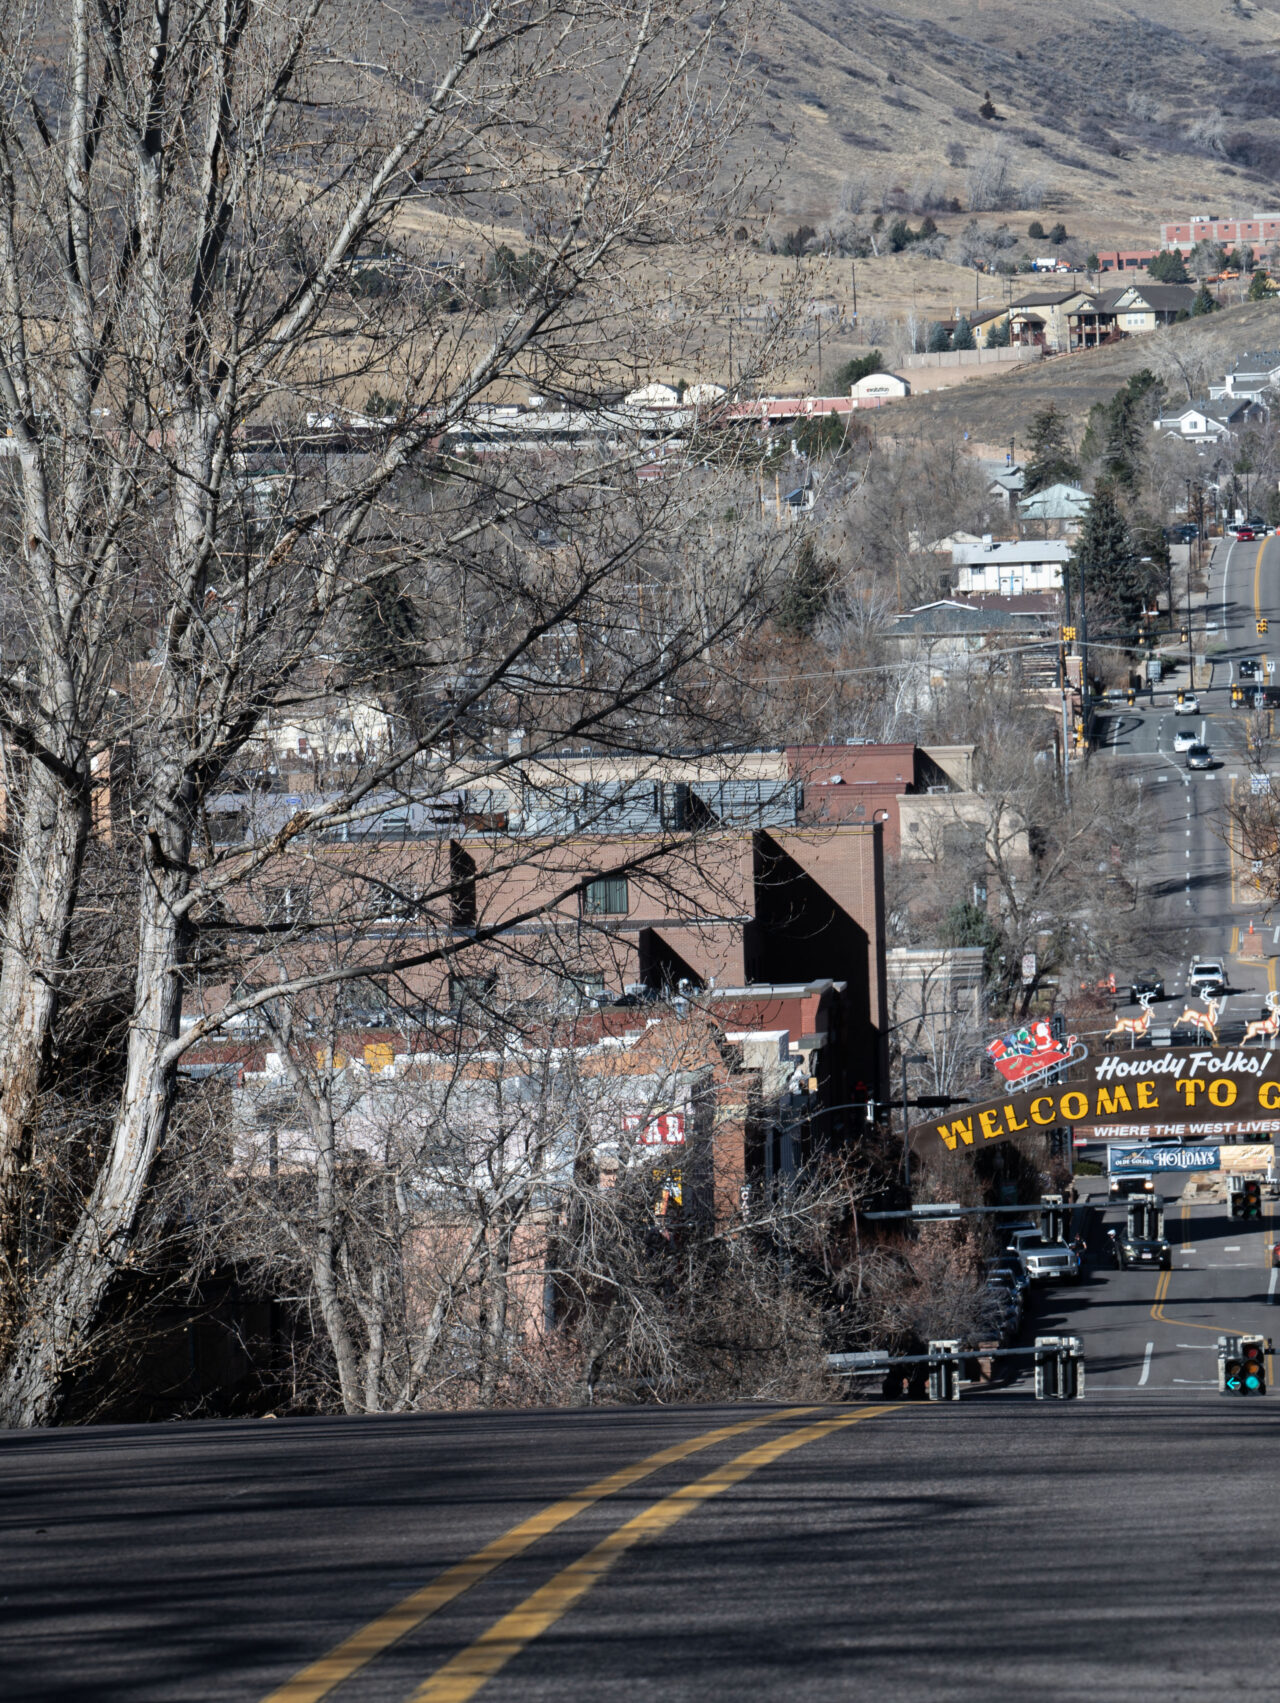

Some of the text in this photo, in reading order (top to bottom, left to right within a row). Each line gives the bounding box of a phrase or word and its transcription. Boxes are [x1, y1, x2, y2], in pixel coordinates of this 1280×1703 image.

[1095, 1051, 1272, 1080] Howdy Folks!
[936, 1080, 1160, 1150] WELCOME
[1175, 1078, 1238, 1107] TO
[1094, 1121, 1280, 1137] WHERE THE WEST LIVES
[1115, 1159, 1130, 1167] OLDE
[1131, 1158, 1155, 1166] GOLDEN
